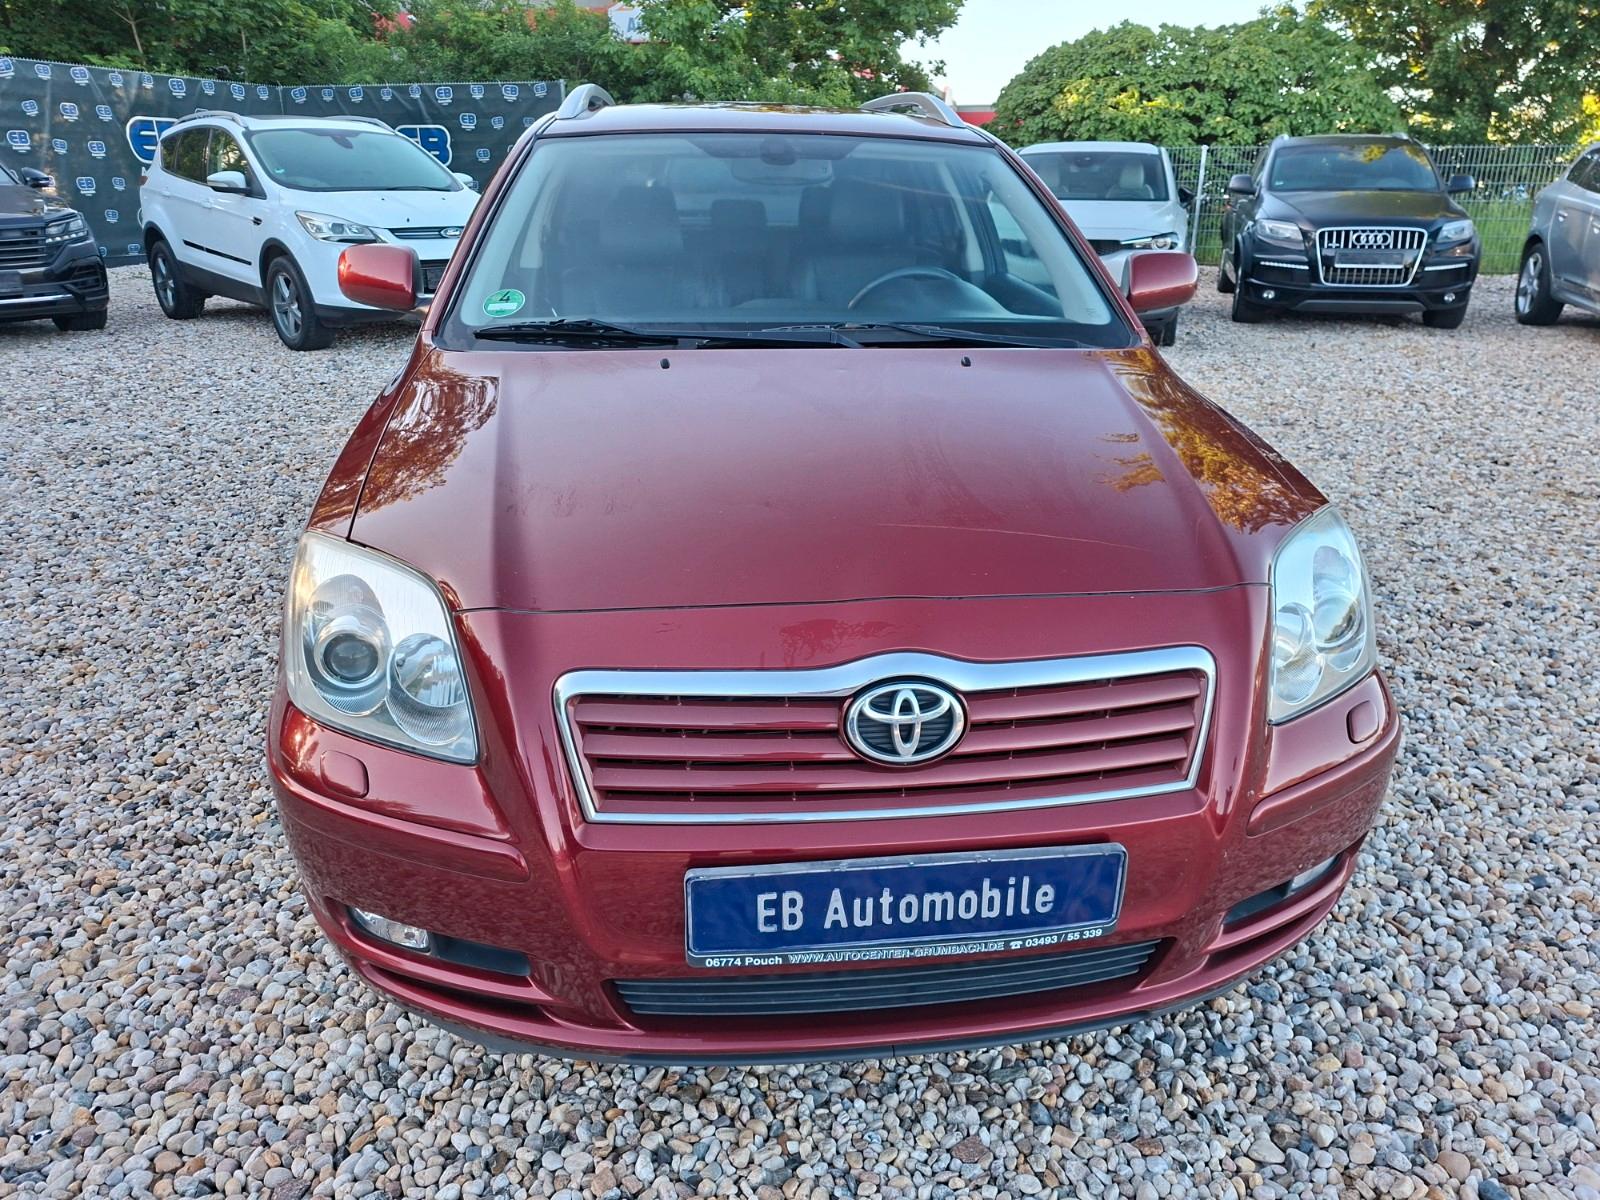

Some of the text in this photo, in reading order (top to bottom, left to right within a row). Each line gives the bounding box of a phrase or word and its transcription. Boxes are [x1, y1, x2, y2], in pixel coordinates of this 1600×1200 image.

[126, 116, 178, 163] E
[498, 290, 511, 303] 4
[756, 876, 1056, 933] EB Automobile
[705, 958, 742, 967] 06774
[744, 956, 783, 967] Pouch
[788, 942, 1005, 964] WWW.AUTOCENTER-GRUMBACH.DE
[1025, 935, 1058, 948] 03493
[1066, 931, 1081, 942] 55
[1083, 928, 1103, 939] 339
